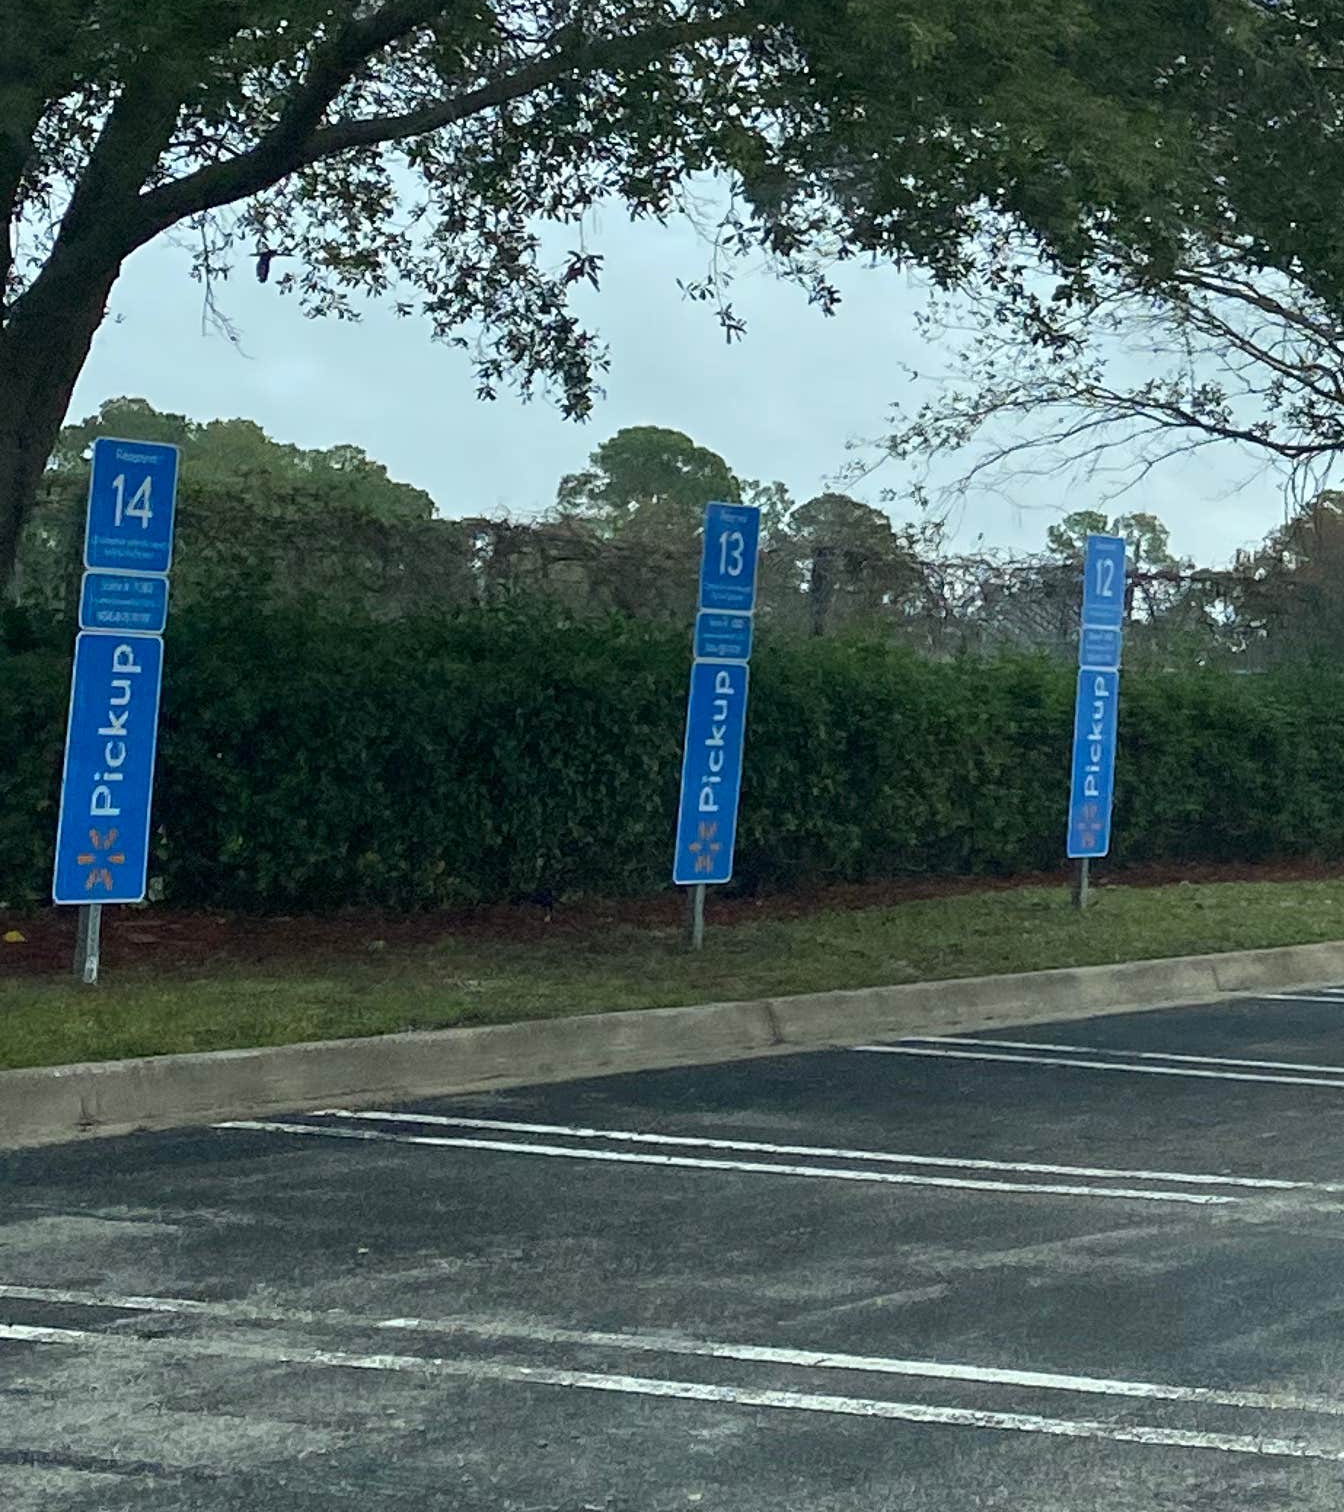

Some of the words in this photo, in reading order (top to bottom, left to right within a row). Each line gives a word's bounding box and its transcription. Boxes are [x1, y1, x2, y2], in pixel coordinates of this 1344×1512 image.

[112, 473, 153, 530] 14
[719, 530, 745, 577] 13
[1095, 557, 1115, 597] 12
[90, 643, 142, 817] Pickup
[698, 669, 735, 812] Pickup
[1084, 675, 1110, 797] Pickup
